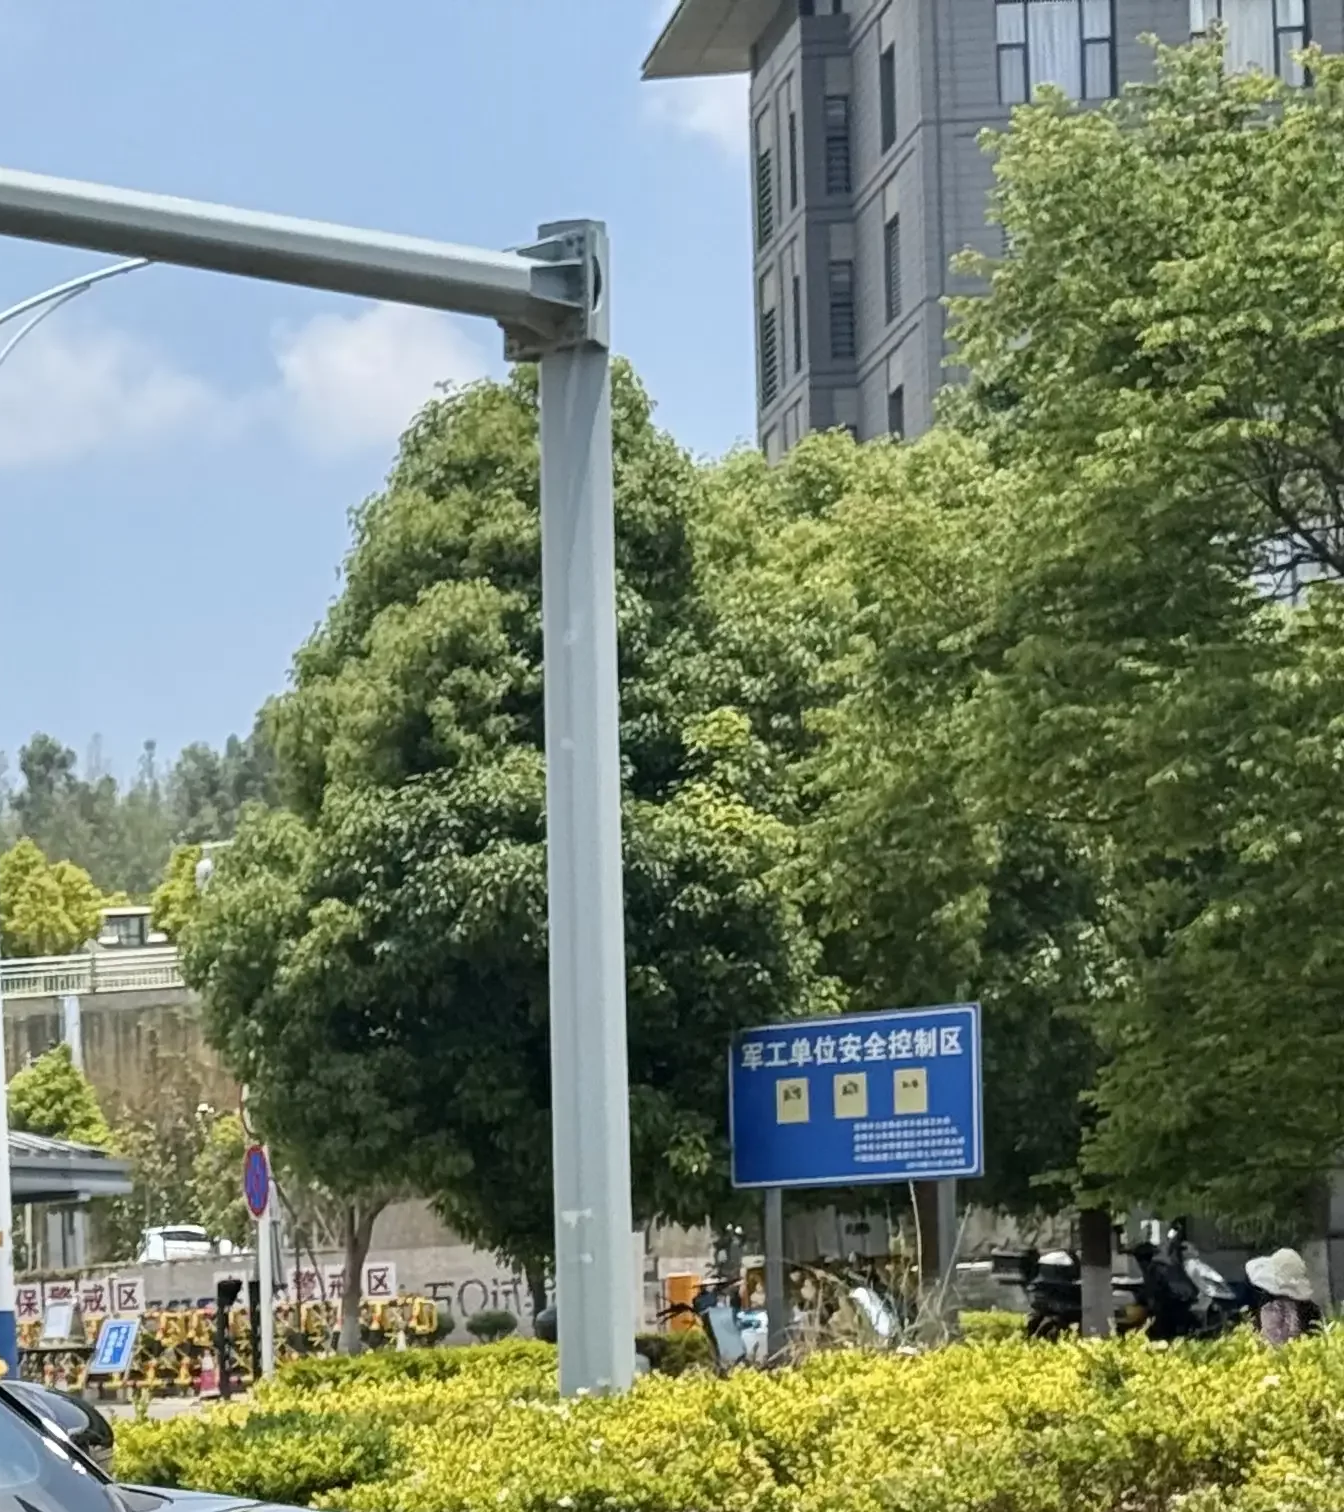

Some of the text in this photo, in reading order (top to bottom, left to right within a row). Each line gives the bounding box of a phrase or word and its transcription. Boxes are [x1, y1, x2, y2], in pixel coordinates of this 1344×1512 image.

[741, 1026, 963, 1071] 军工单位安全控制区
